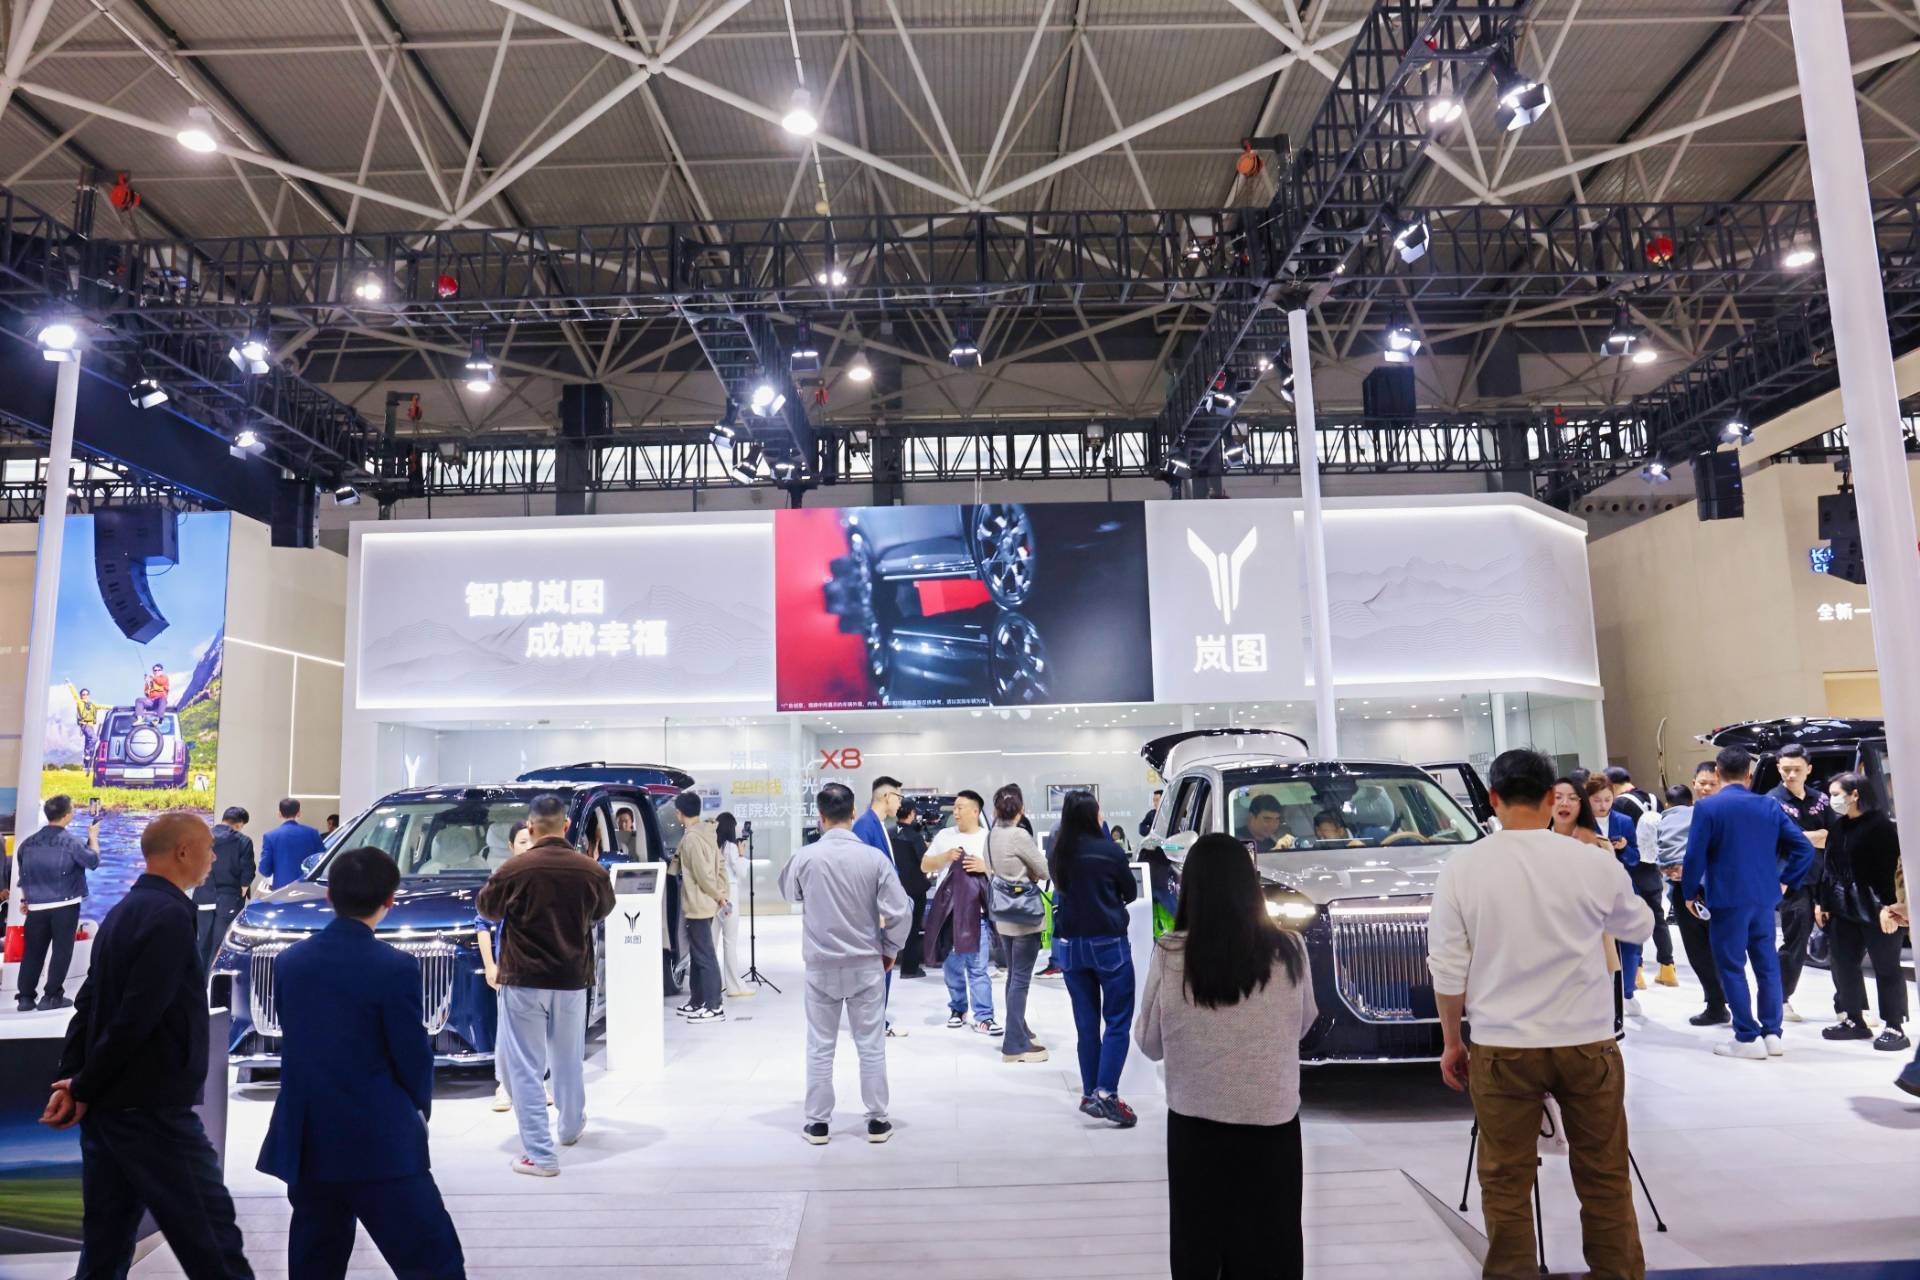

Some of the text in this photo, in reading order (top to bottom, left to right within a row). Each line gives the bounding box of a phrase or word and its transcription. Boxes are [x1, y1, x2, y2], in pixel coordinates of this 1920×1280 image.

[465, 579, 604, 616] 智慧岚图
[525, 620, 667, 658] 成就幸福
[1193, 633, 1268, 673] 岚图
[819, 747, 862, 770] X8
